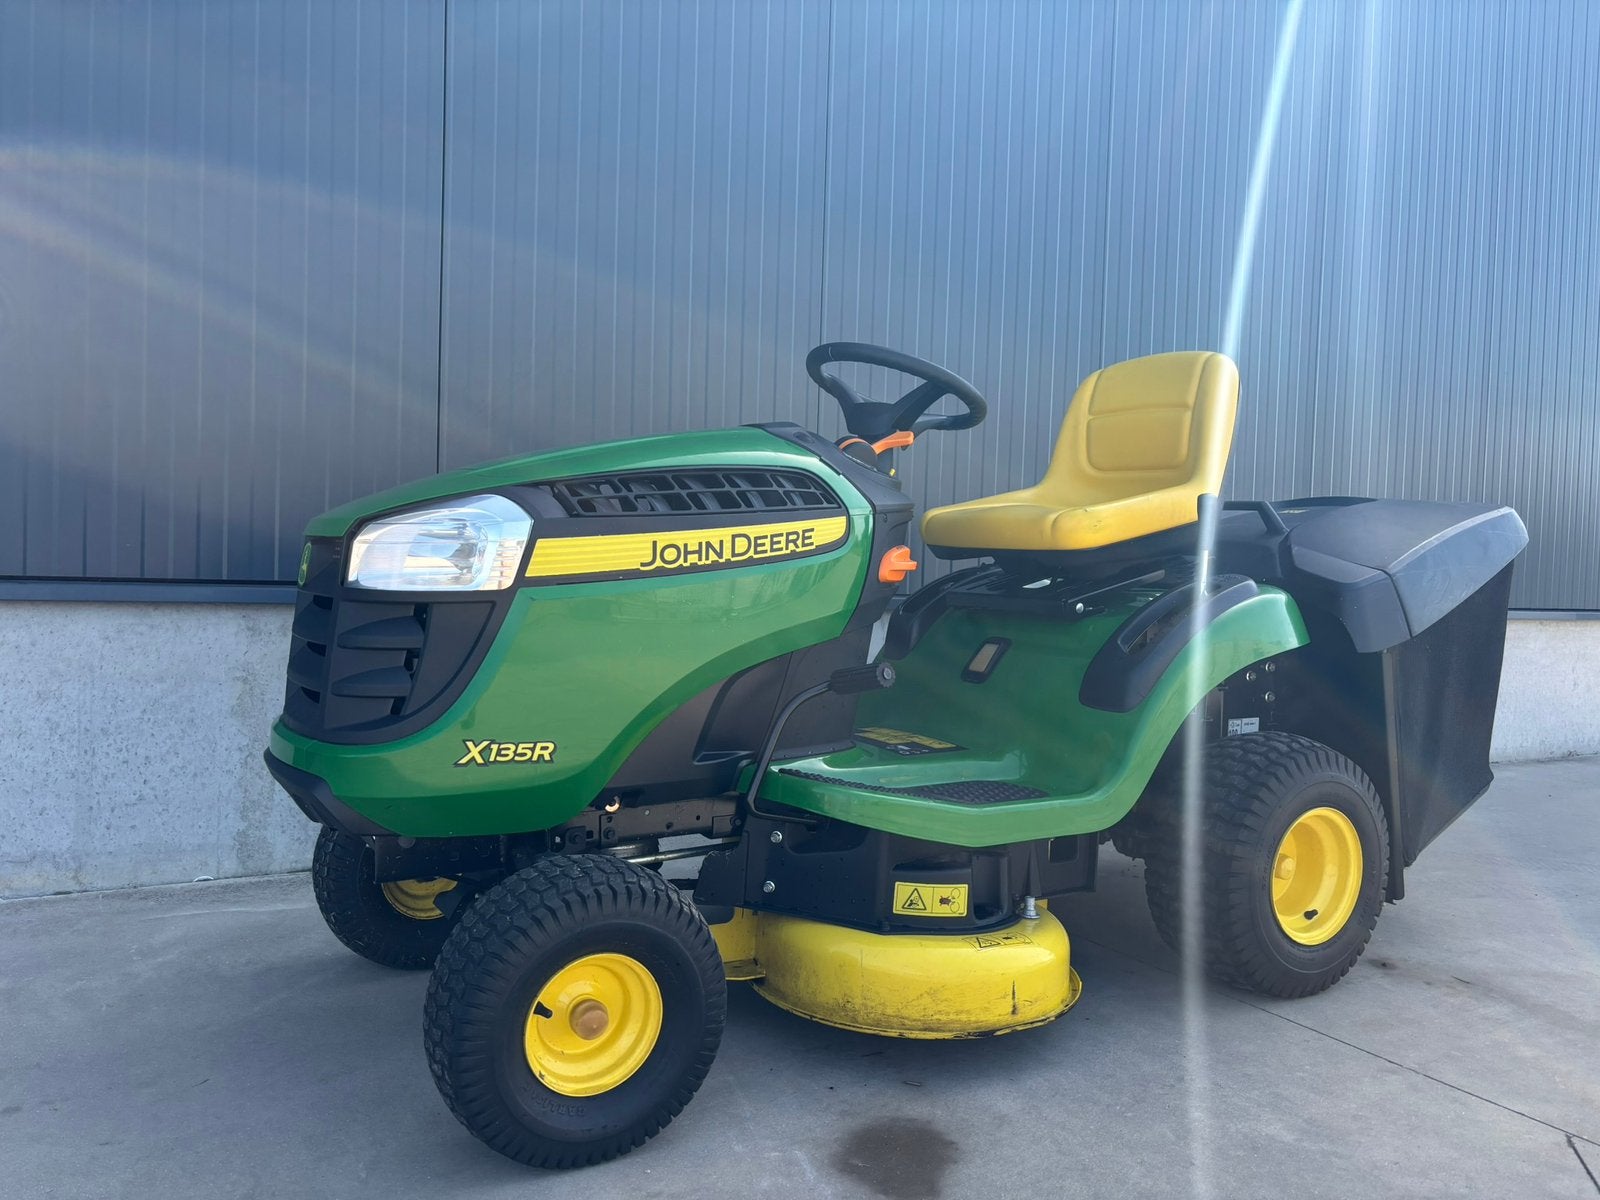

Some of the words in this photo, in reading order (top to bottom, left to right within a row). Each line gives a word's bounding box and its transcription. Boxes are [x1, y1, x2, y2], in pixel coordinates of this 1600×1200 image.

[640, 539, 724, 568] JOHN
[731, 528, 815, 558] DEERE
[454, 739, 556, 767] X135R
